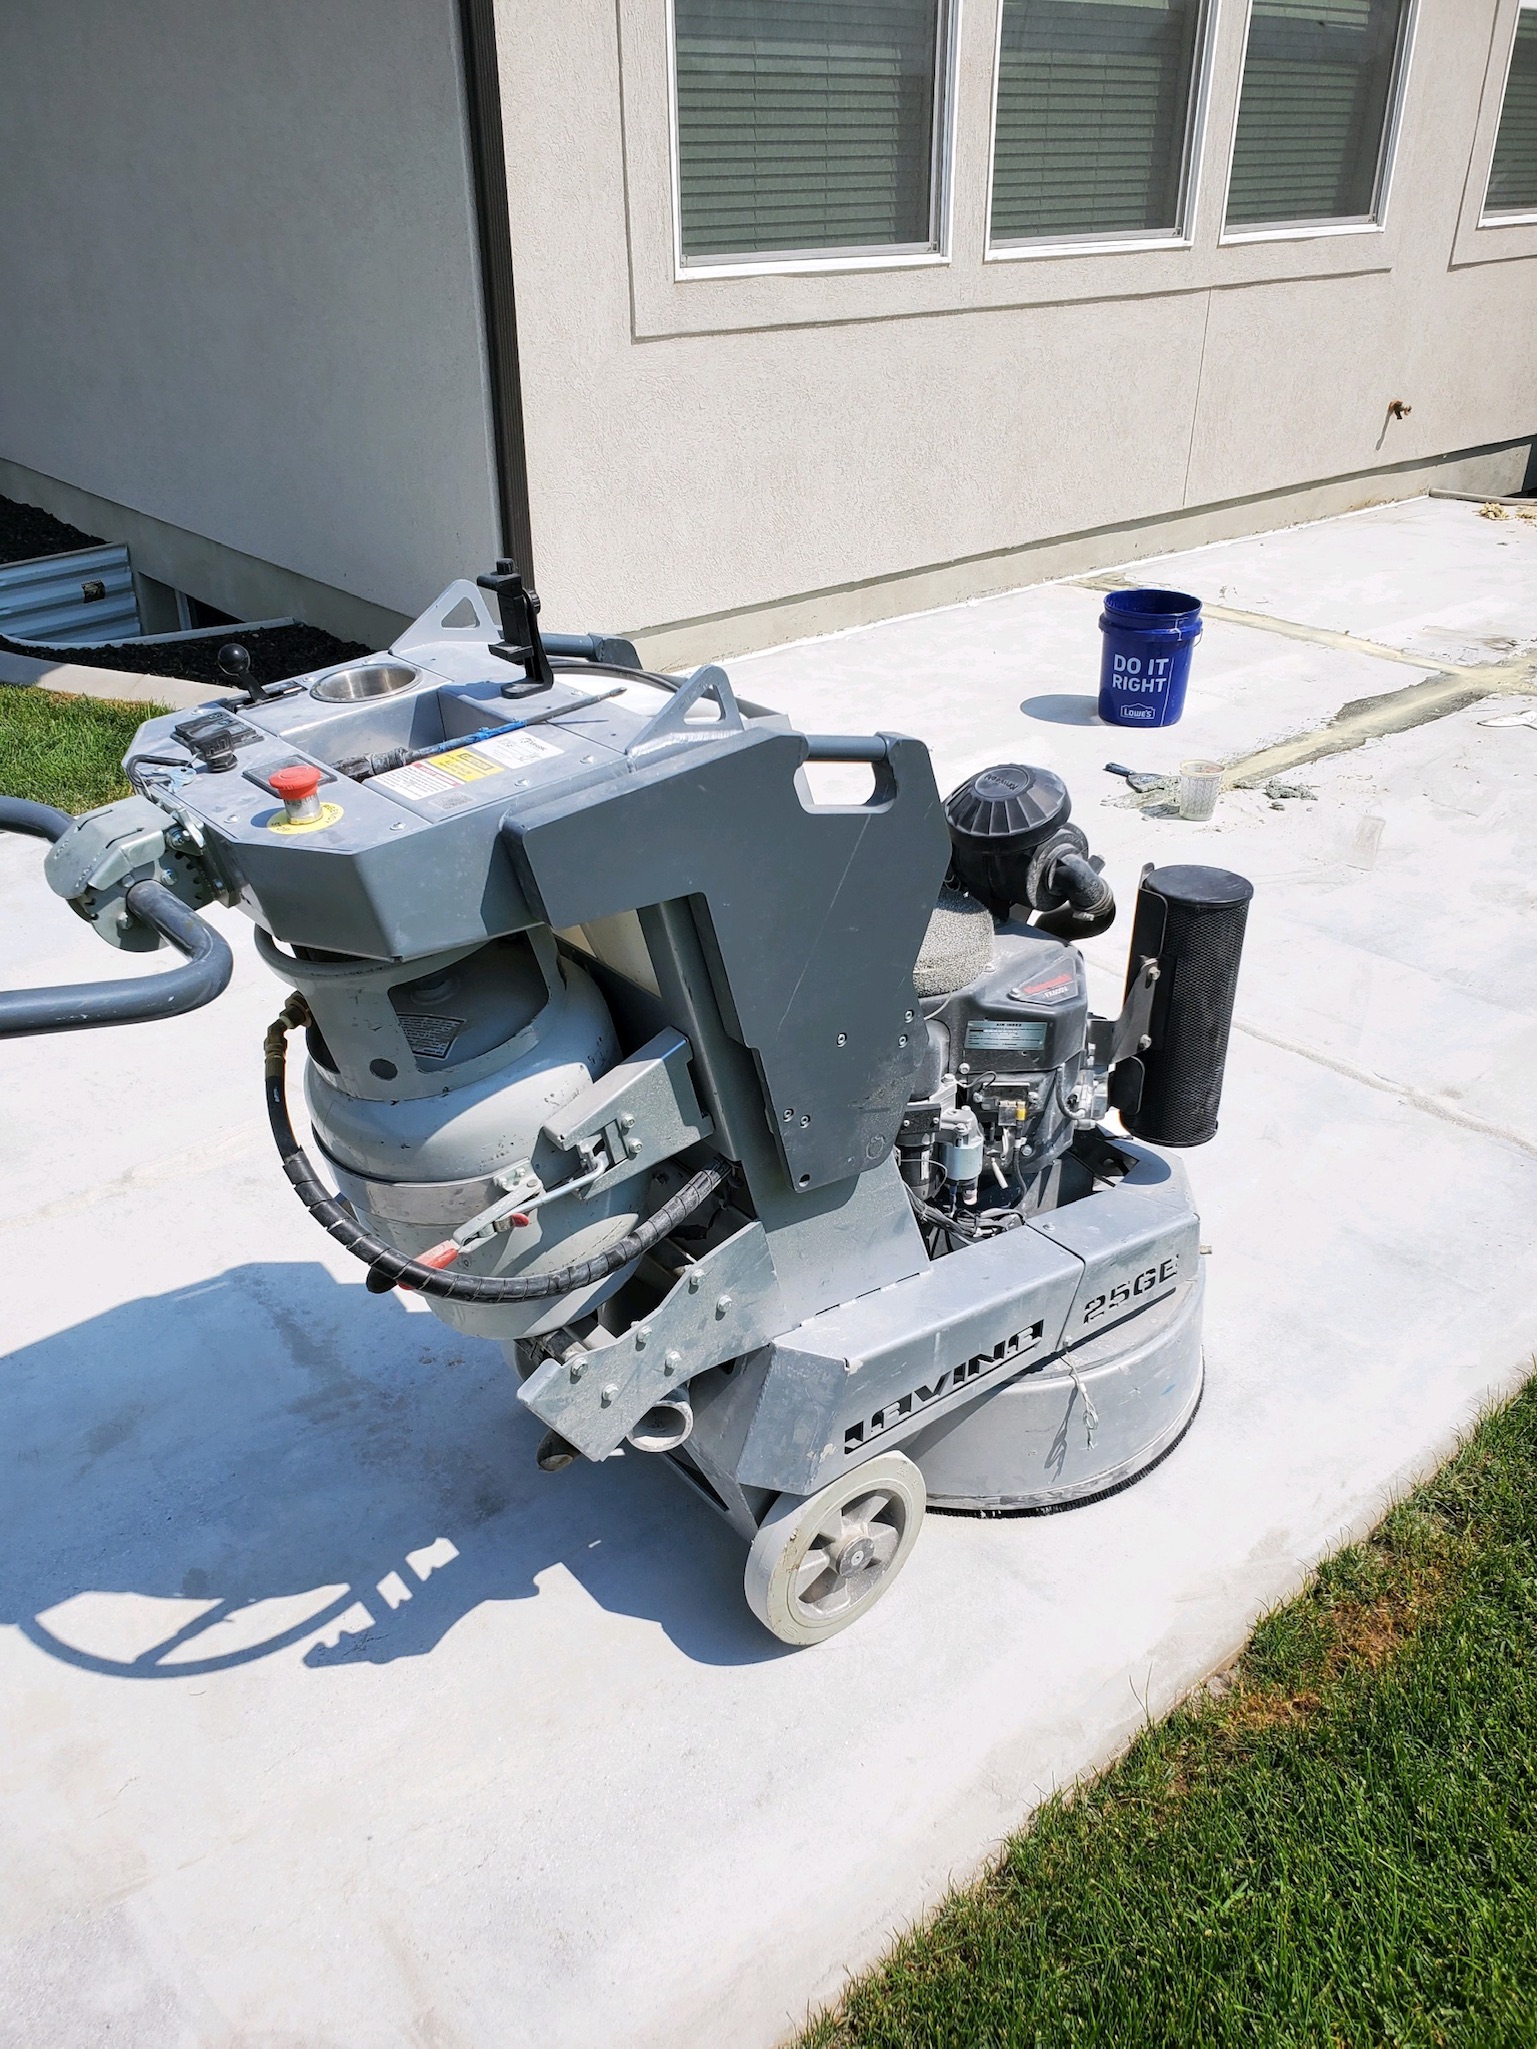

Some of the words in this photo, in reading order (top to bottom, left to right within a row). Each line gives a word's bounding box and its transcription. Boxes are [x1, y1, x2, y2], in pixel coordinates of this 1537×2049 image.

[1113, 654, 1141, 674] DO
[1148, 658, 1169, 675] IT
[1112, 673, 1167, 692] RIGHT
[1123, 707, 1152, 718] LOWE'S
[1083, 1254, 1179, 1324] 25GE
